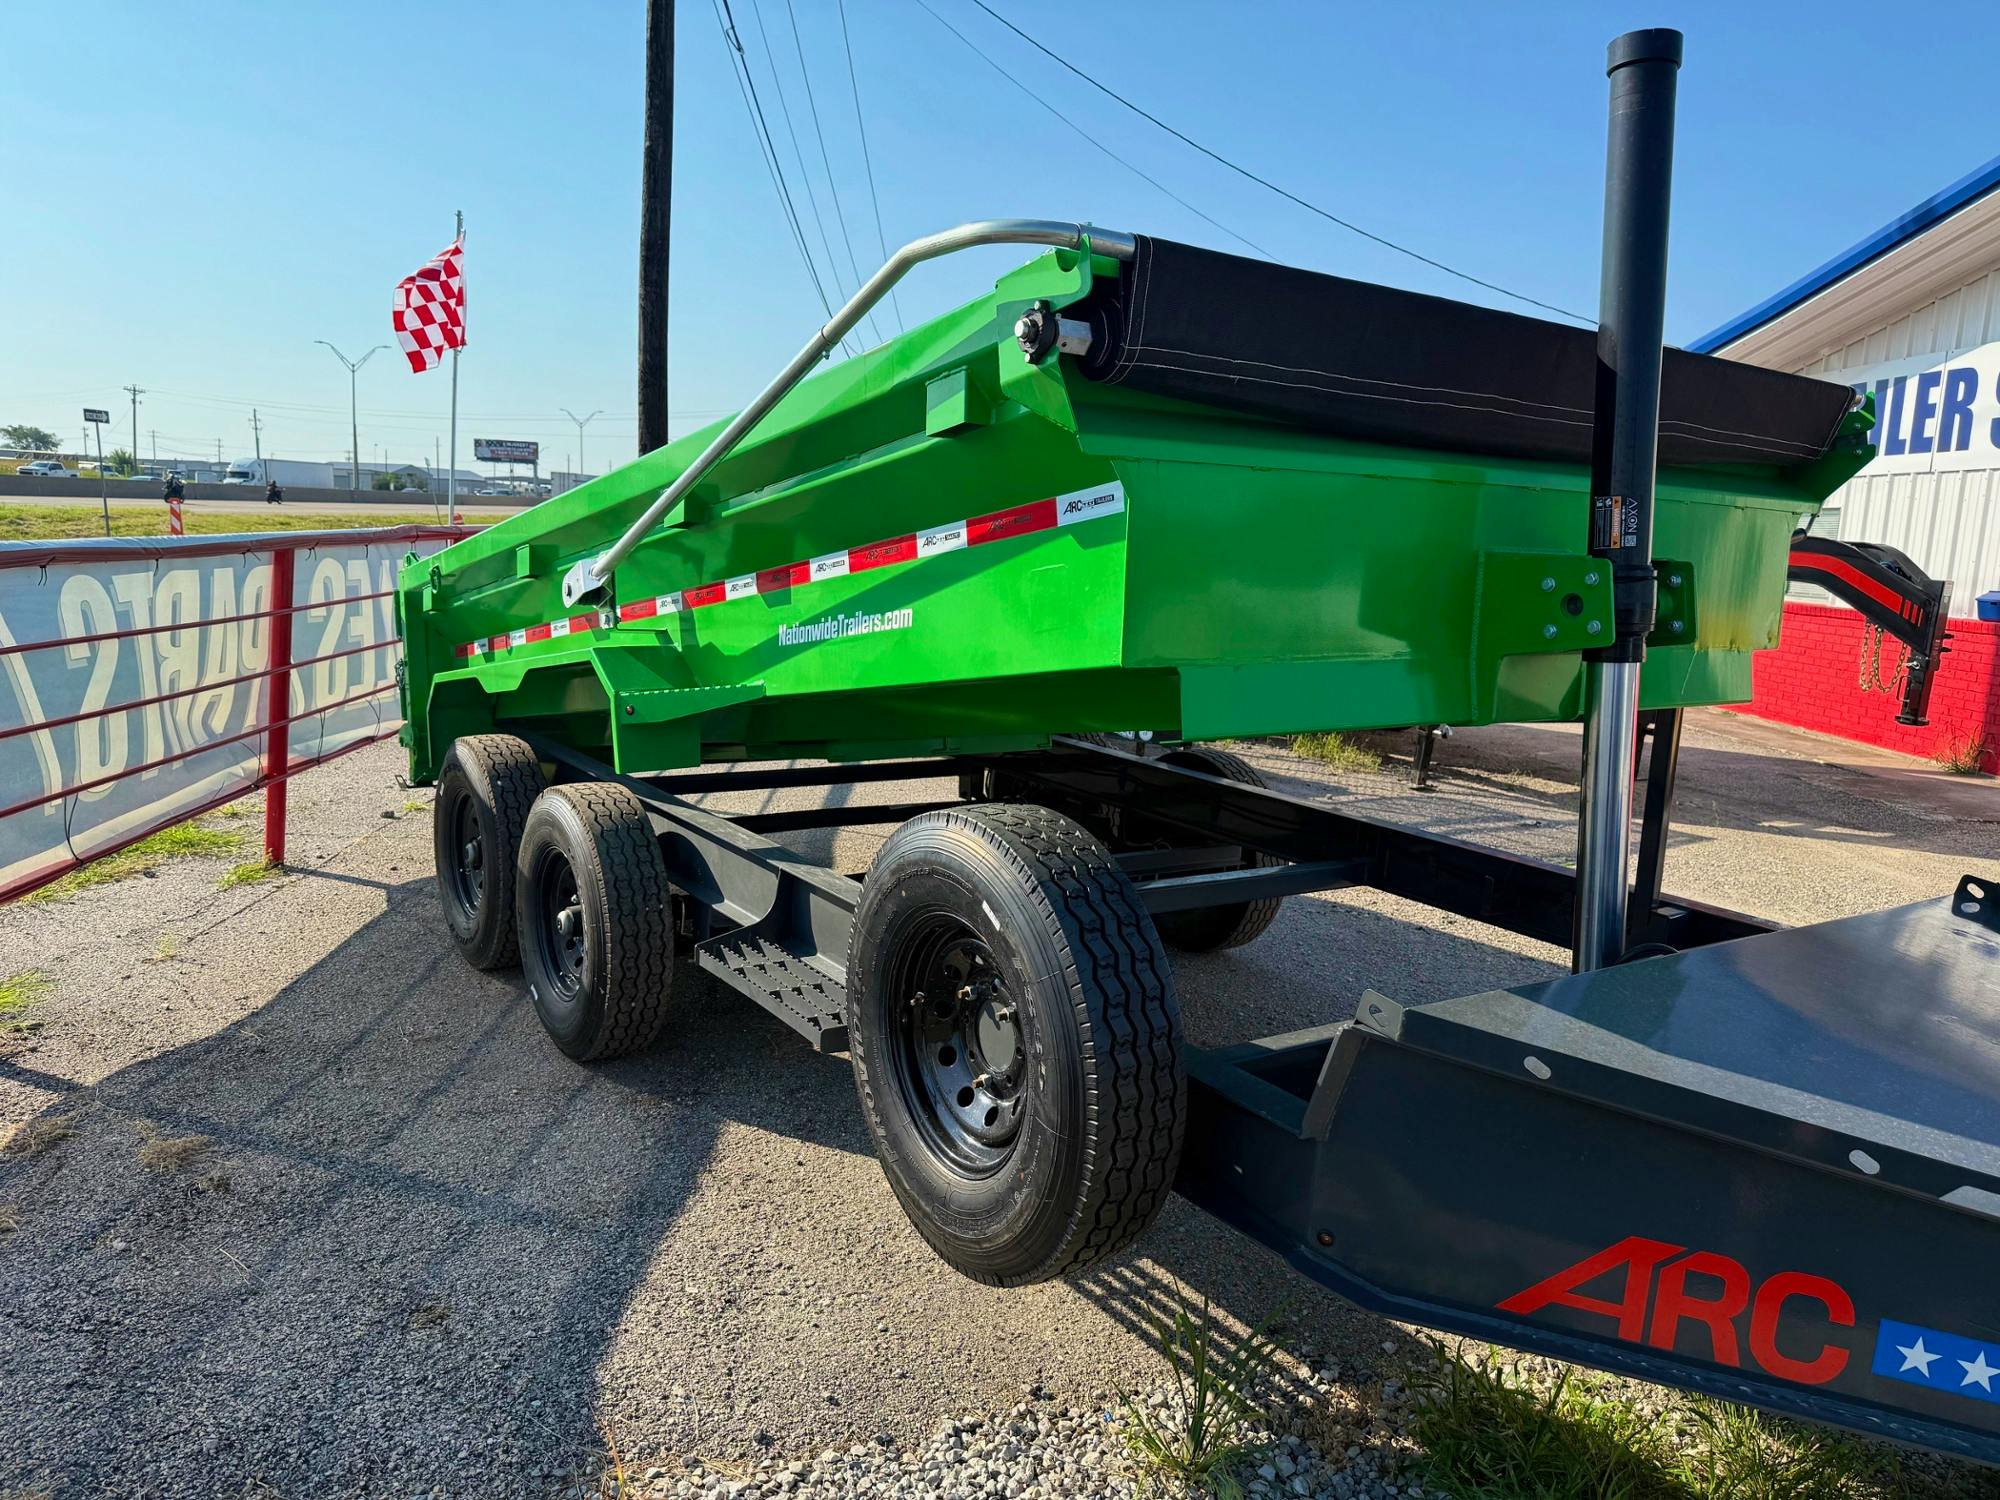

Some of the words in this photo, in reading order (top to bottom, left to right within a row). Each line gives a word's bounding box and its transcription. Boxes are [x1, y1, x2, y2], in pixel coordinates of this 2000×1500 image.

[1852, 367, 1979, 457] ILER
[1063, 499, 1083, 515] ARC
[922, 534, 937, 548] ARC
[778, 608, 913, 646] NationwideTrailers.com
[1494, 1236, 1855, 1385] ARC
